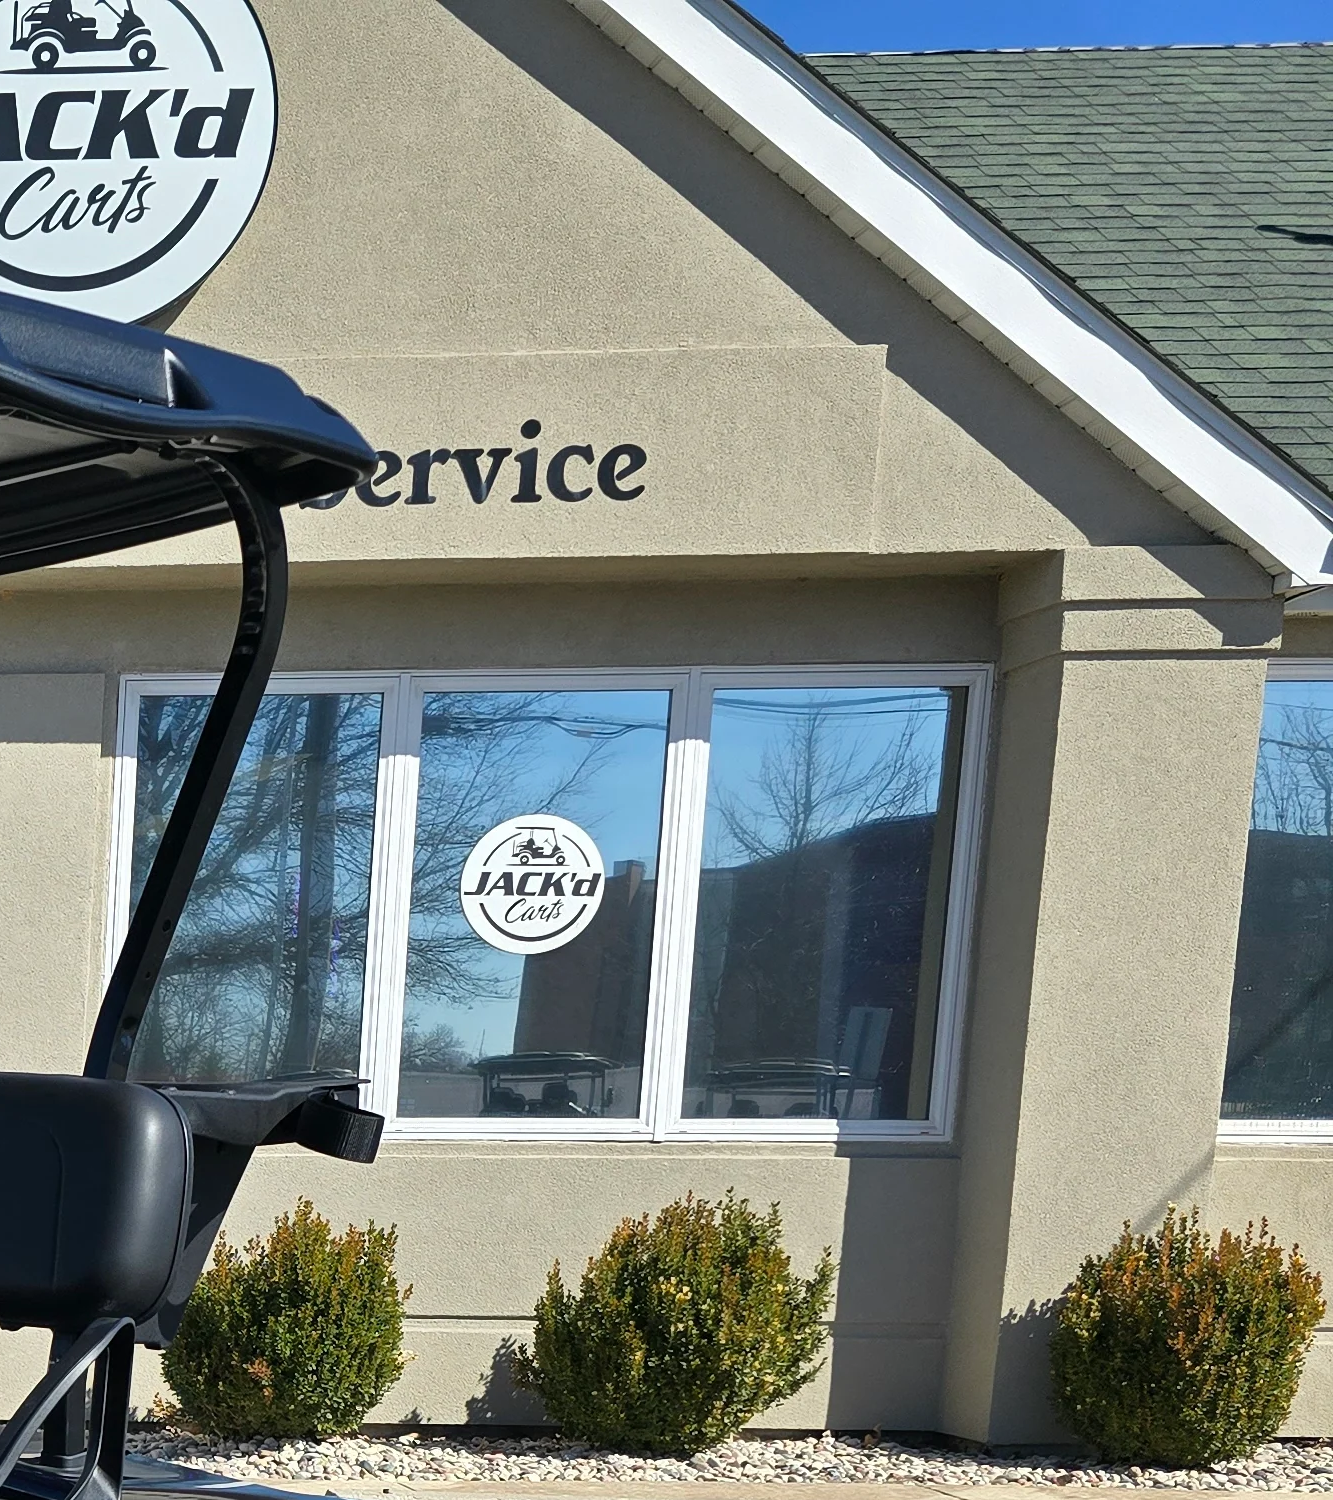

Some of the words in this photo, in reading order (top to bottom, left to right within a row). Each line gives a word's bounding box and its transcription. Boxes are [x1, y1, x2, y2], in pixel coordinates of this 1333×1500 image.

[299, 419, 647, 510] ervice
[463, 872, 602, 896] JACK'd
[505, 898, 564, 923] Carts
